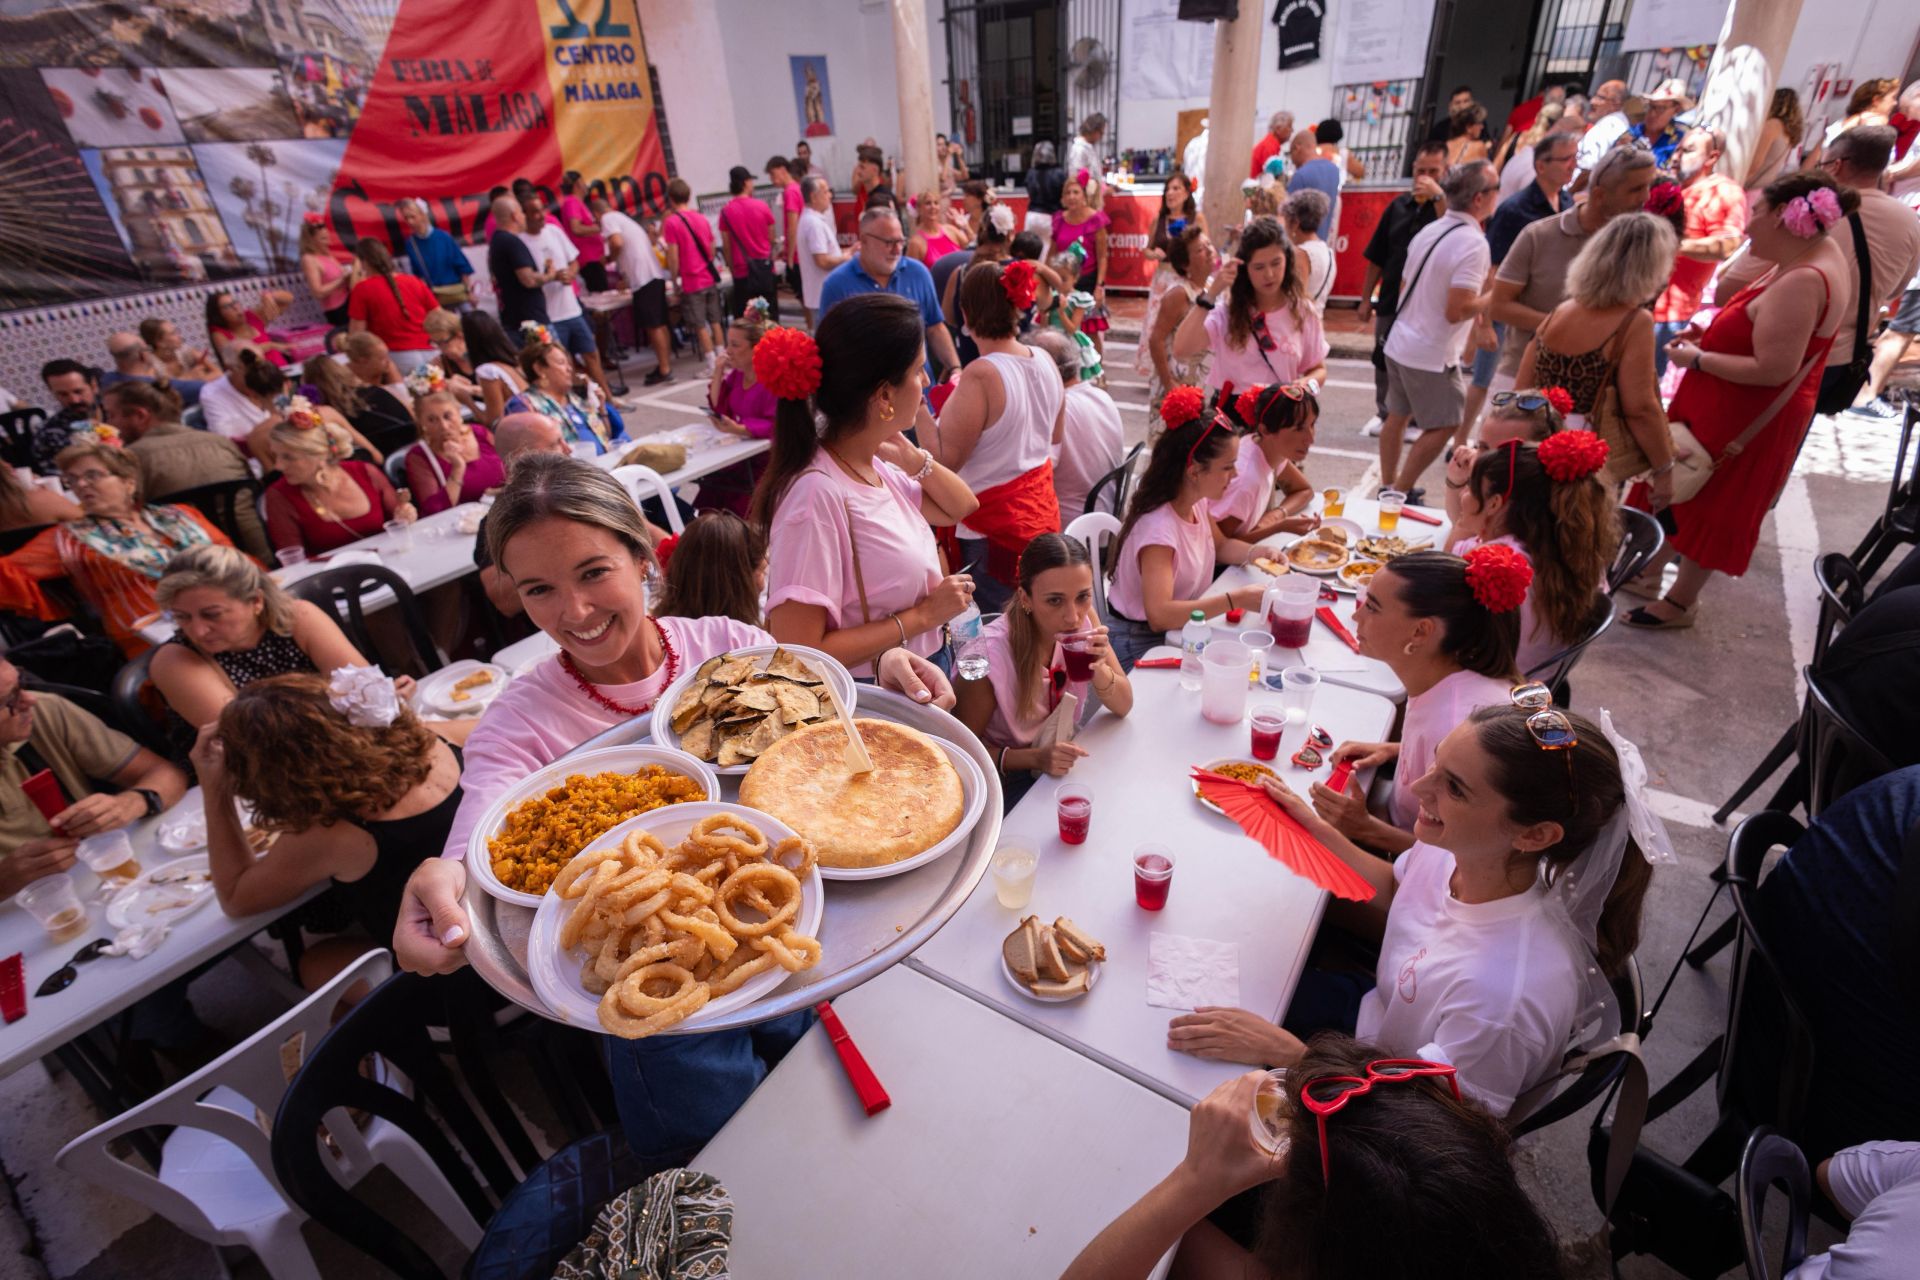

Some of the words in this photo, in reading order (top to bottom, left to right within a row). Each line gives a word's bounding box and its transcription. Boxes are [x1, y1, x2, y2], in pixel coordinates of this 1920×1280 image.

[554, 44, 636, 66] CENTRO
[390, 59, 473, 82] FERIA
[564, 79, 642, 102] MÁLAGA
[403, 90, 548, 136] MÁLAGA
